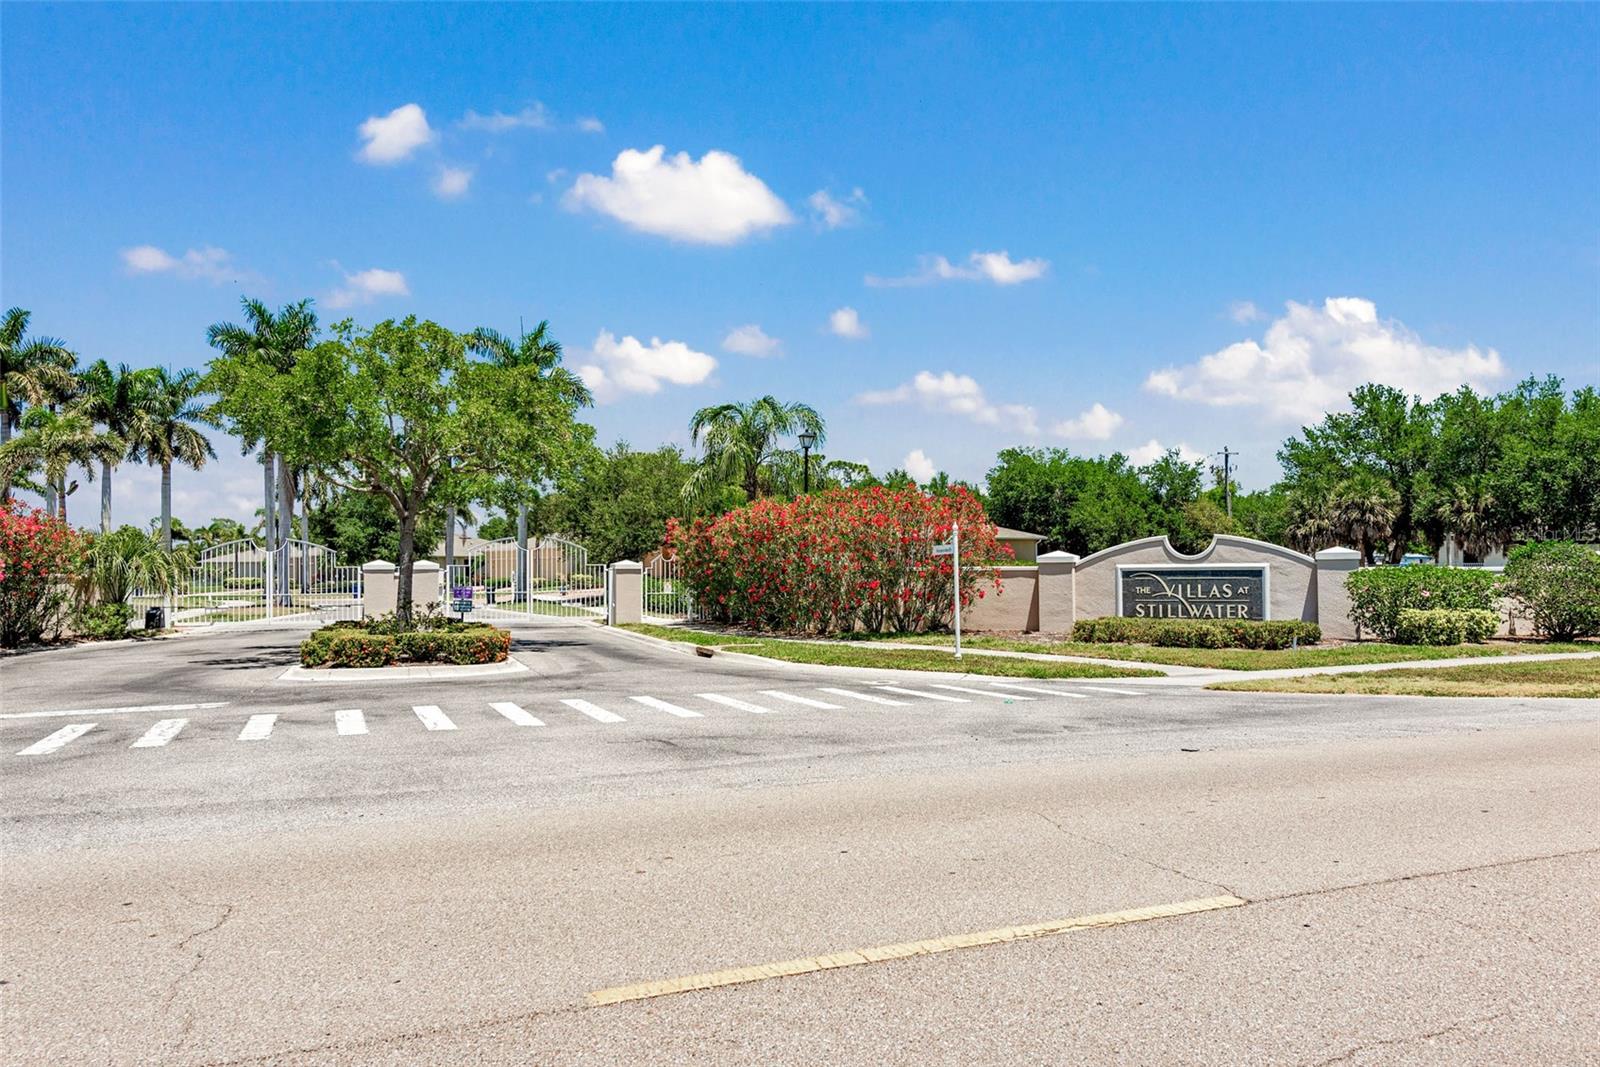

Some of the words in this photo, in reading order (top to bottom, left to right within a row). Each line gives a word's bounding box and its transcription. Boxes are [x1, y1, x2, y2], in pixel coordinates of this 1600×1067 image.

[1135, 586, 1151, 594] THE
[1163, 583, 1233, 598] VILLAS
[1237, 586, 1250, 595] AT
[1135, 603, 1249, 619] STILLWATER
